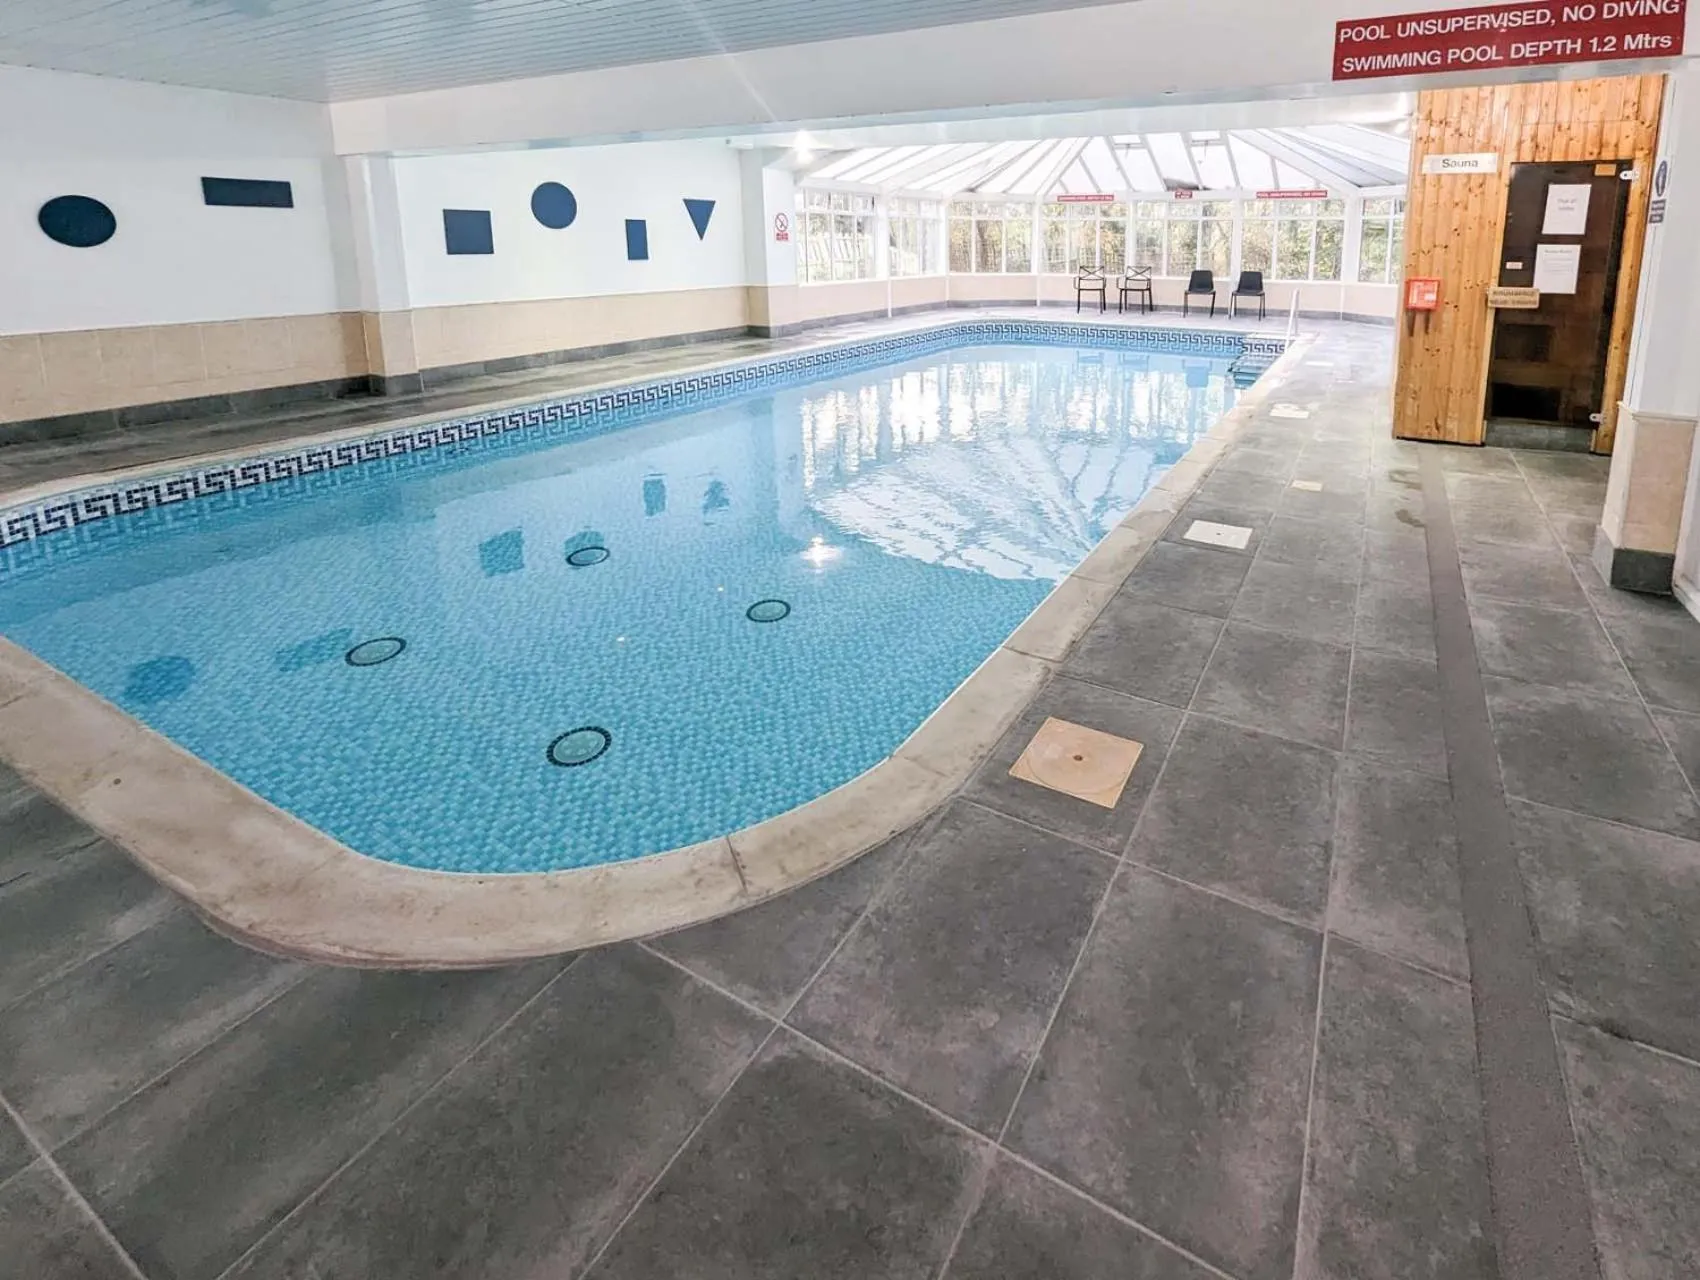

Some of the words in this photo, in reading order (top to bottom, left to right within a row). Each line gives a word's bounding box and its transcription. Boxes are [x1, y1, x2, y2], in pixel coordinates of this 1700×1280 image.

[1340, 25, 1391, 43] POOL
[1397, 8, 1556, 38] UNSUPERVISED,
[1563, 4, 1596, 22] NO
[1602, 0, 1680, 19] DIVING
[1342, 50, 1441, 73] SWIMMING
[1447, 45, 1503, 64] POOL
[1510, 38, 1581, 59] DEPTH
[1589, 36, 1617, 53] 1.2
[1623, 33, 1672, 50] Mtrs
[1442, 158, 1479, 168] Sauna
